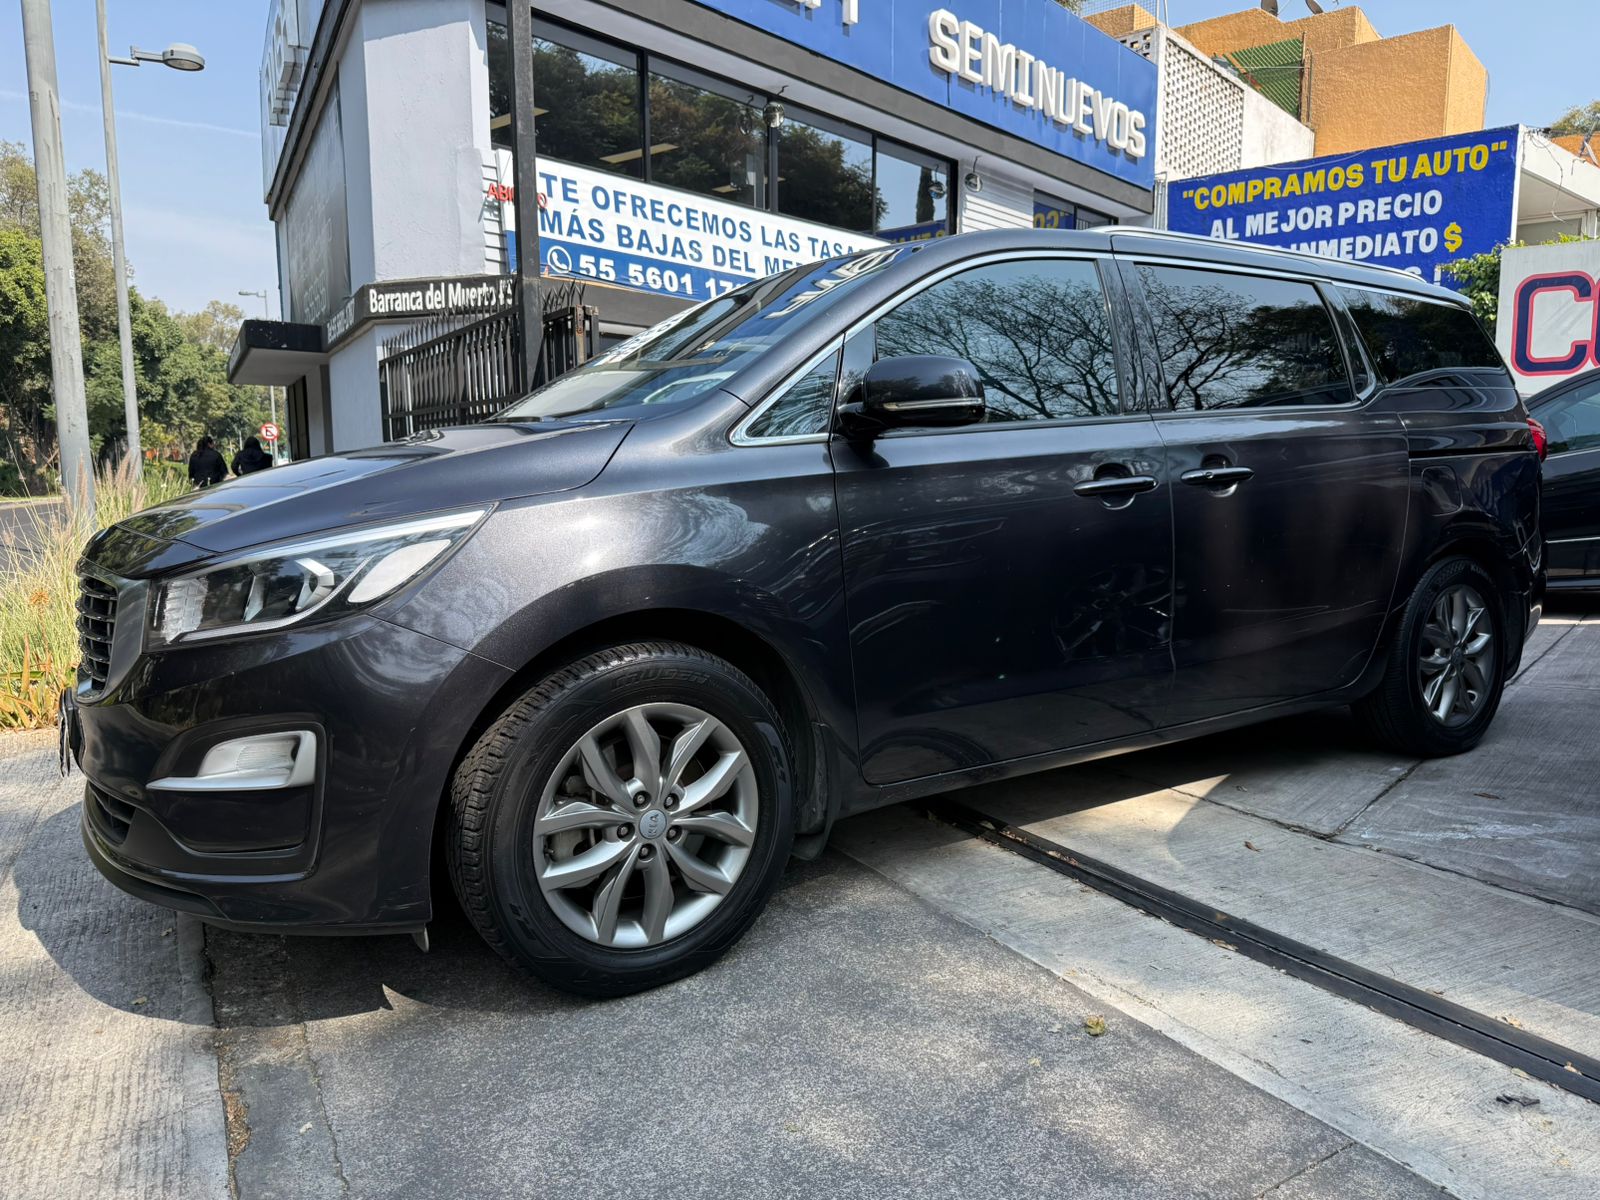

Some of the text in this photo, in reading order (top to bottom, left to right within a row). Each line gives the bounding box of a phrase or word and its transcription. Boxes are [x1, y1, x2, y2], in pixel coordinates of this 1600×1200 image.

[928, 8, 1146, 158] SEMINUEVOS
[1182, 141, 1508, 210] "COMPRAMOS TU AUTO"
[539, 171, 580, 204] TE
[591, 185, 752, 243] OFRECEMOS
[761, 225, 800, 253] LAS
[807, 236, 864, 259] TASA
[539, 208, 803, 276] MÁS BAJAS DEL ME
[1209, 189, 1442, 240] AL MEJOR PRECIO
[1291, 221, 1463, 260] NMEDIATO $
[369, 289, 424, 314] Barranca
[425, 282, 445, 310] del
[448, 282, 497, 308] Muerto
[579, 254, 744, 300] 55 5601 17
[1511, 270, 1600, 377] C
